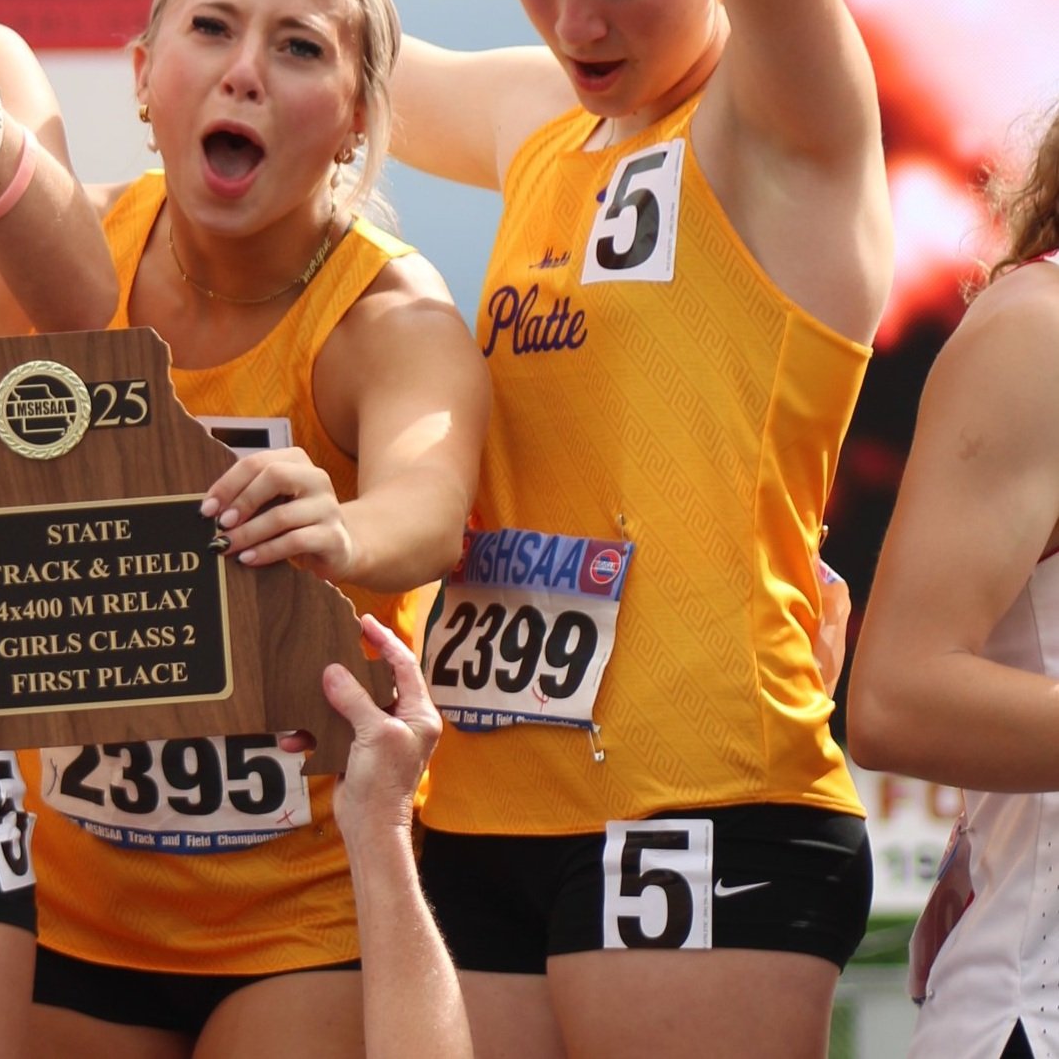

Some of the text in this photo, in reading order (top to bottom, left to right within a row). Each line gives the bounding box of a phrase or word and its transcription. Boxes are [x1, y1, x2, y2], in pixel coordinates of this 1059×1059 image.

[596, 150, 668, 271] 5
[482, 282, 588, 359] Platte
[16, 399, 67, 418] MSHSAA
[92, 381, 149, 427] 25
[47, 519, 132, 546] STATE
[88, 557, 110, 579] &
[117, 551, 201, 577] FIELD
[70, 595, 94, 617] M
[102, 587, 194, 615] RELAY
[88, 625, 177, 652] CLASS
[182, 624, 197, 646] 2
[431, 600, 599, 700] 2399
[11, 661, 189, 695] FIRST PLACE
[60, 733, 287, 817] 2395
[127, 830, 156, 846] Track
[161, 833, 181, 847] and
[186, 834, 212, 848] Field
[616, 829, 694, 949] 5
